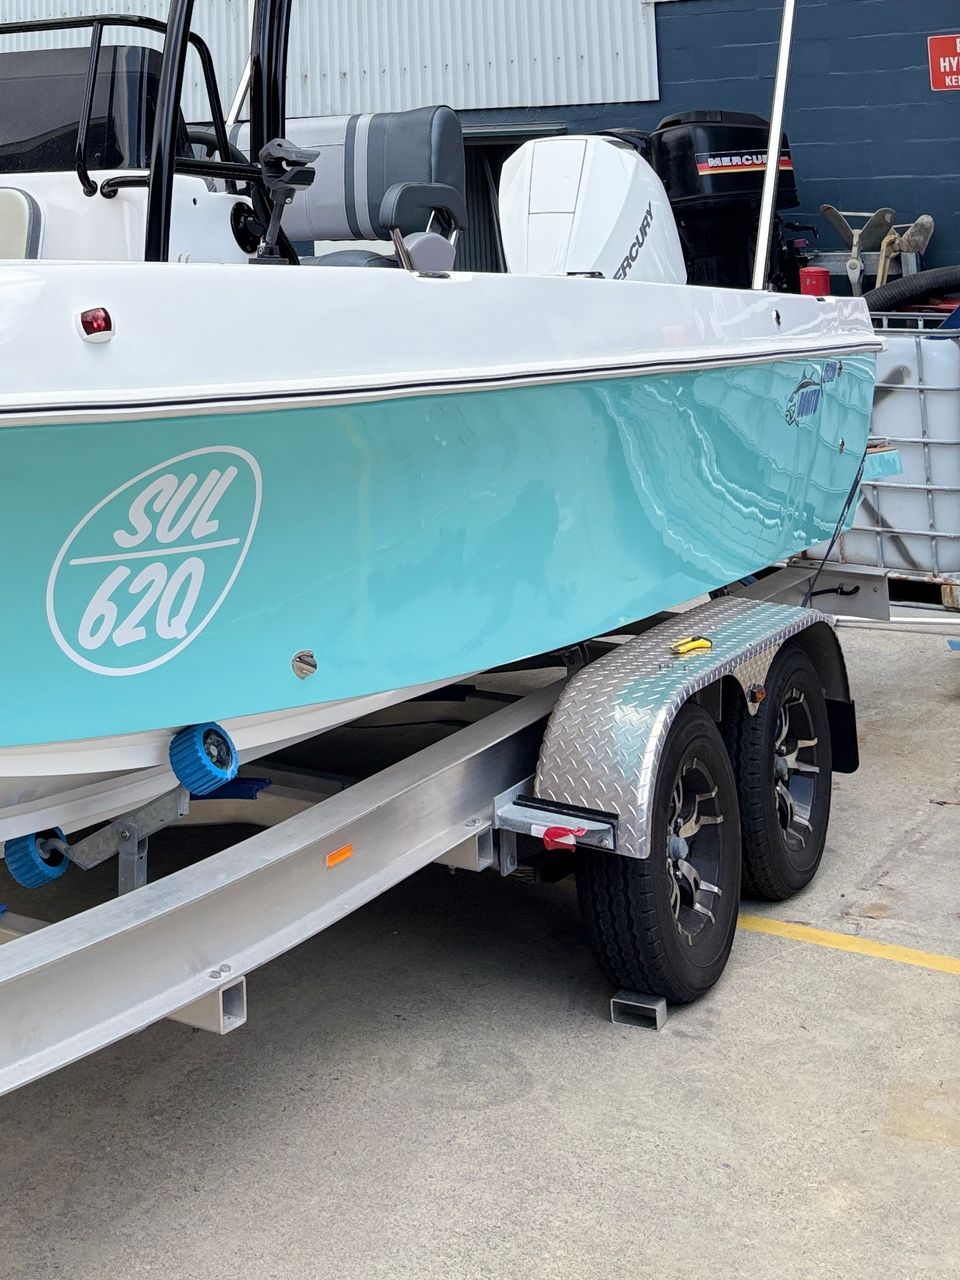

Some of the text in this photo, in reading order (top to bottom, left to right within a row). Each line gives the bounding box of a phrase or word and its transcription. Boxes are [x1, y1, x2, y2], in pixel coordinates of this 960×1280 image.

[707, 154, 769, 168] MERCU
[613, 200, 654, 280] ERCURY
[113, 465, 238, 548] SUL
